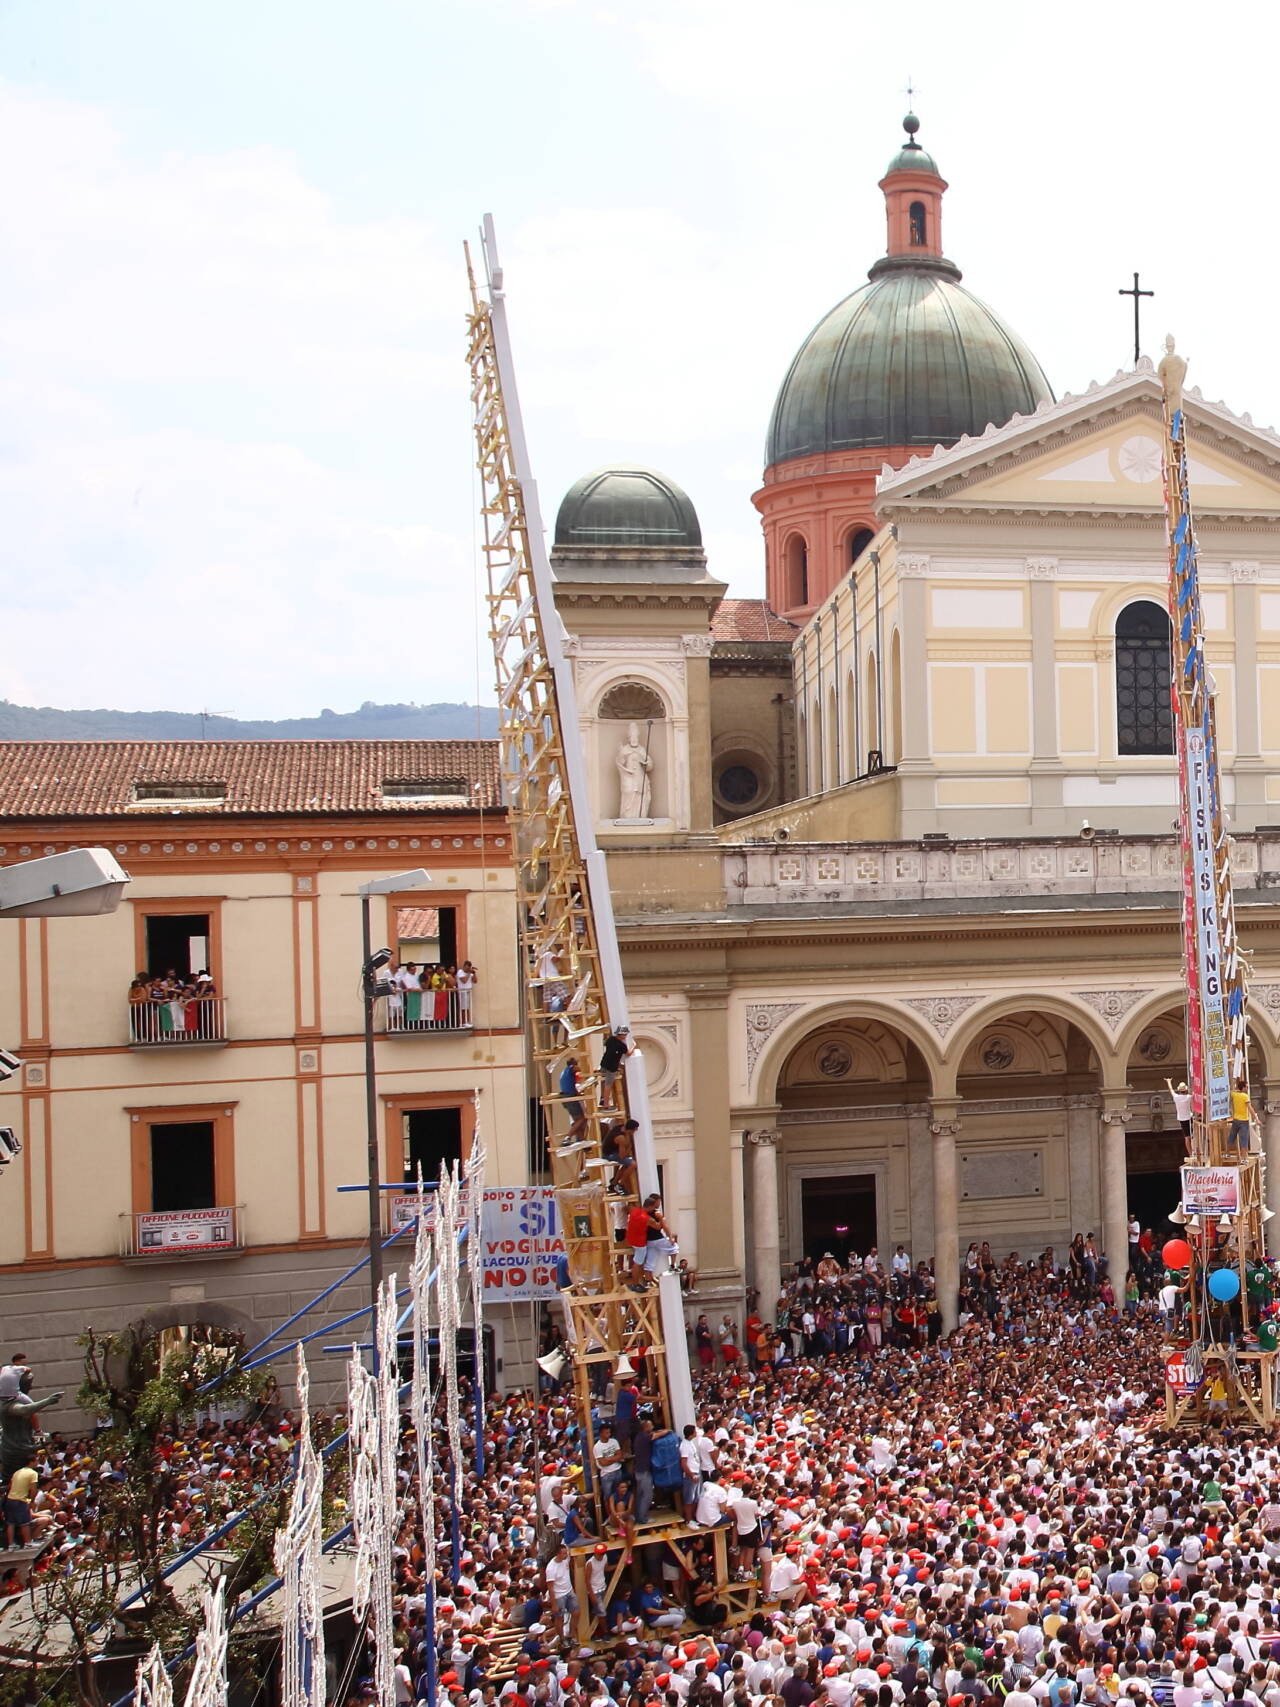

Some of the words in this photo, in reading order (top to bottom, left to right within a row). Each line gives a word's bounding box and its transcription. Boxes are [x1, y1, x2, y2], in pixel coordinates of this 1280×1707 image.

[1193, 761, 1211, 892] FISH'S
[1202, 906, 1219, 996] KING
[1186, 1171, 1234, 1185] Macelleria
[483, 1191, 515, 1201] DOPO
[520, 1189, 537, 1200] 27
[502, 1203, 513, 1212] DI
[141, 1213, 178, 1223] OFFICINE
[519, 1201, 555, 1236] SI
[484, 1267, 526, 1288] NO
